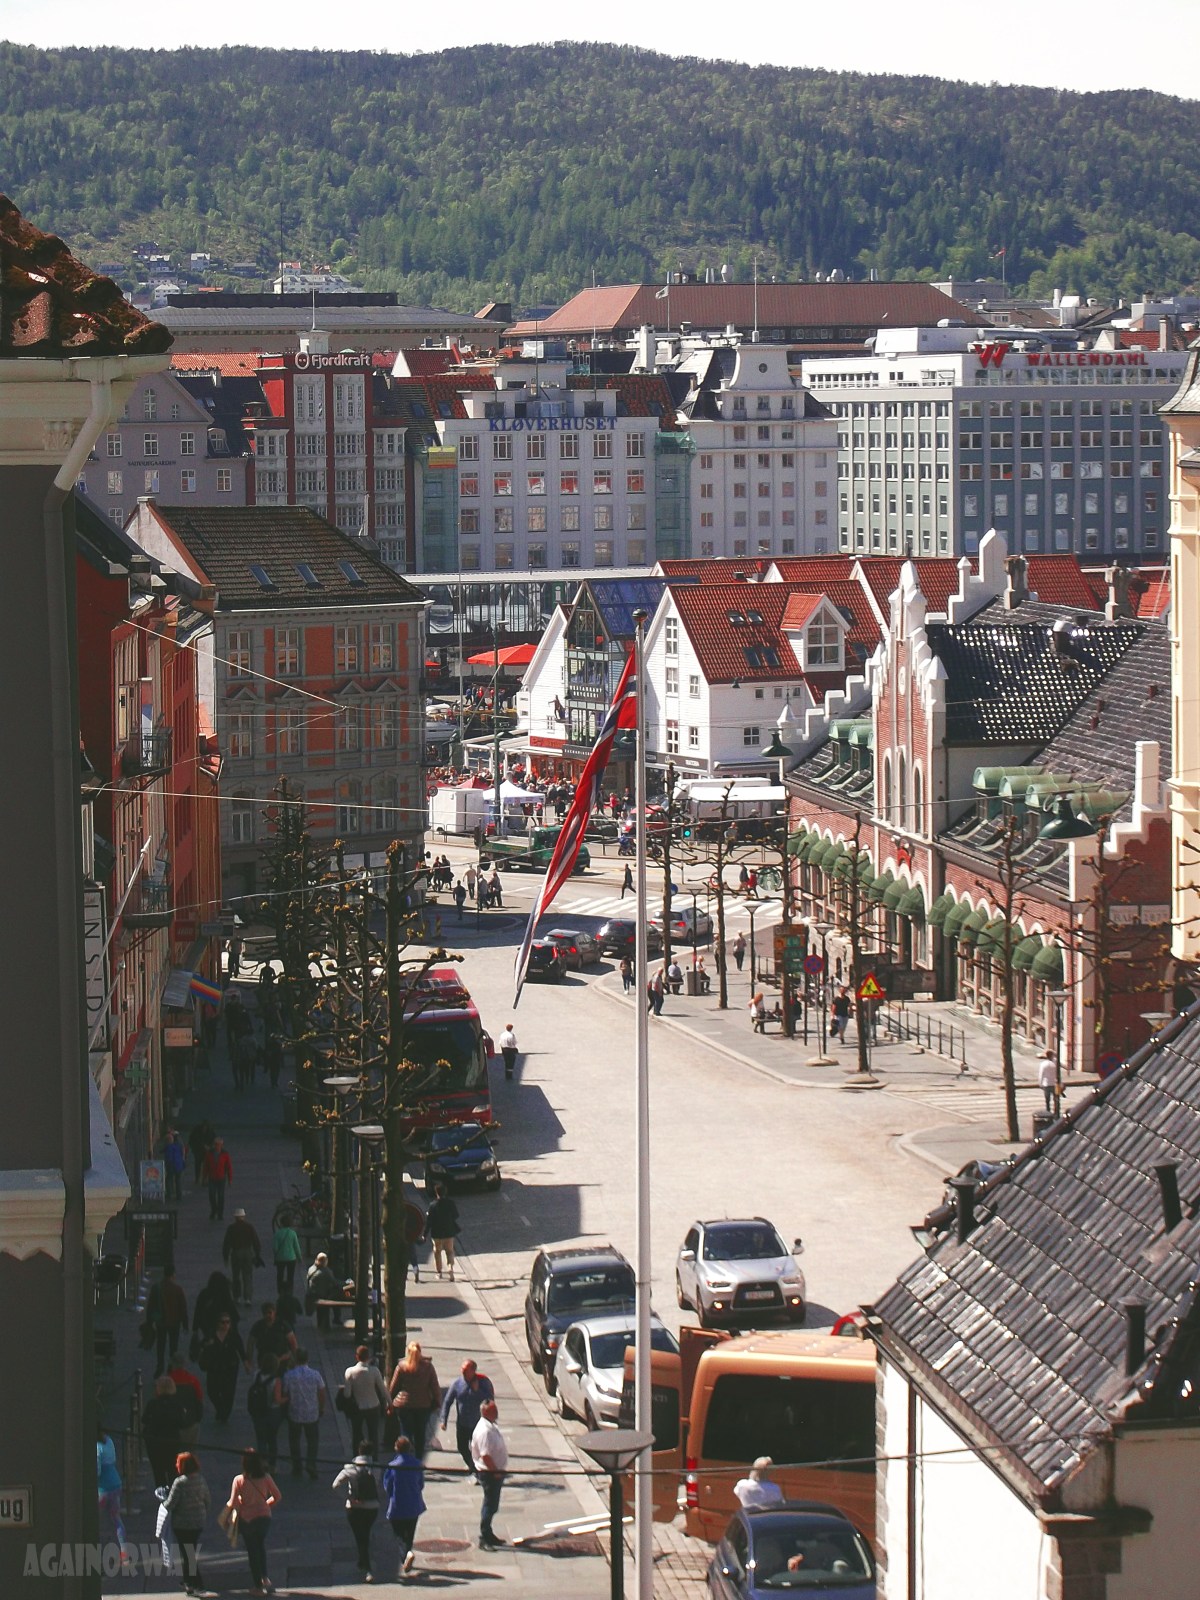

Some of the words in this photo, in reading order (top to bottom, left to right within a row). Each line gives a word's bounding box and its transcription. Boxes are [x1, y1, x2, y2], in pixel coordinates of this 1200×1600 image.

[311, 354, 371, 369] Fjordkraft
[1026, 353, 1148, 366] WALLENDAHL
[489, 417, 618, 431] KLØVERHUSET
